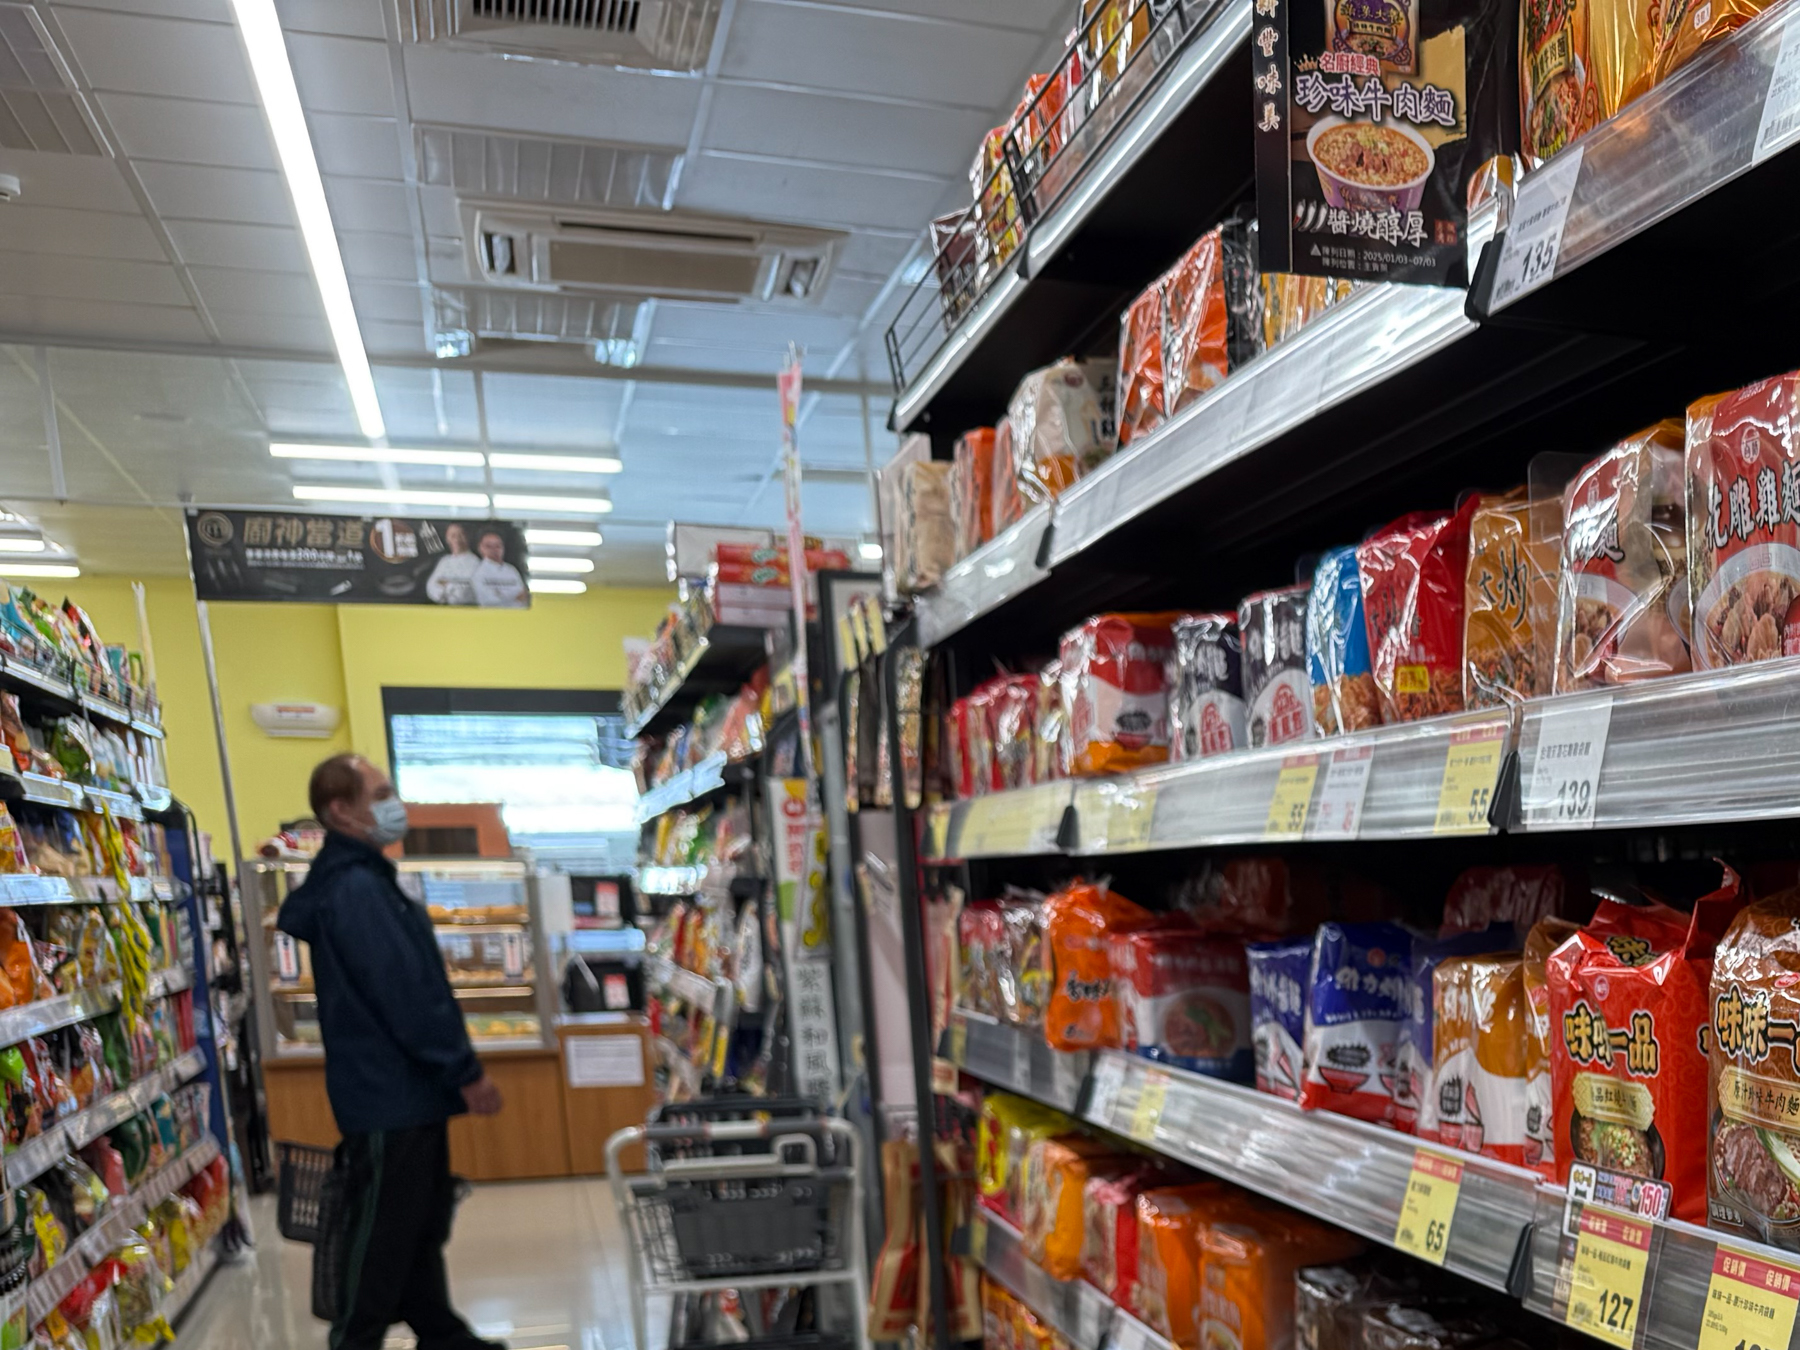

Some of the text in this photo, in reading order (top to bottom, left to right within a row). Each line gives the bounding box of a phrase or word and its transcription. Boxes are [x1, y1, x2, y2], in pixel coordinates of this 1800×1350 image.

[1319, 50, 1381, 77] 名廚經典
[1295, 72, 1456, 126] 珍味牛肉麵
[1327, 208, 1429, 248] 醬燒醇厚
[1521, 233, 1558, 284] 135
[1468, 787, 1490, 822] 55
[1556, 779, 1591, 818] 139
[1425, 1219, 1446, 1253] 65
[1598, 1288, 1635, 1331] 127
